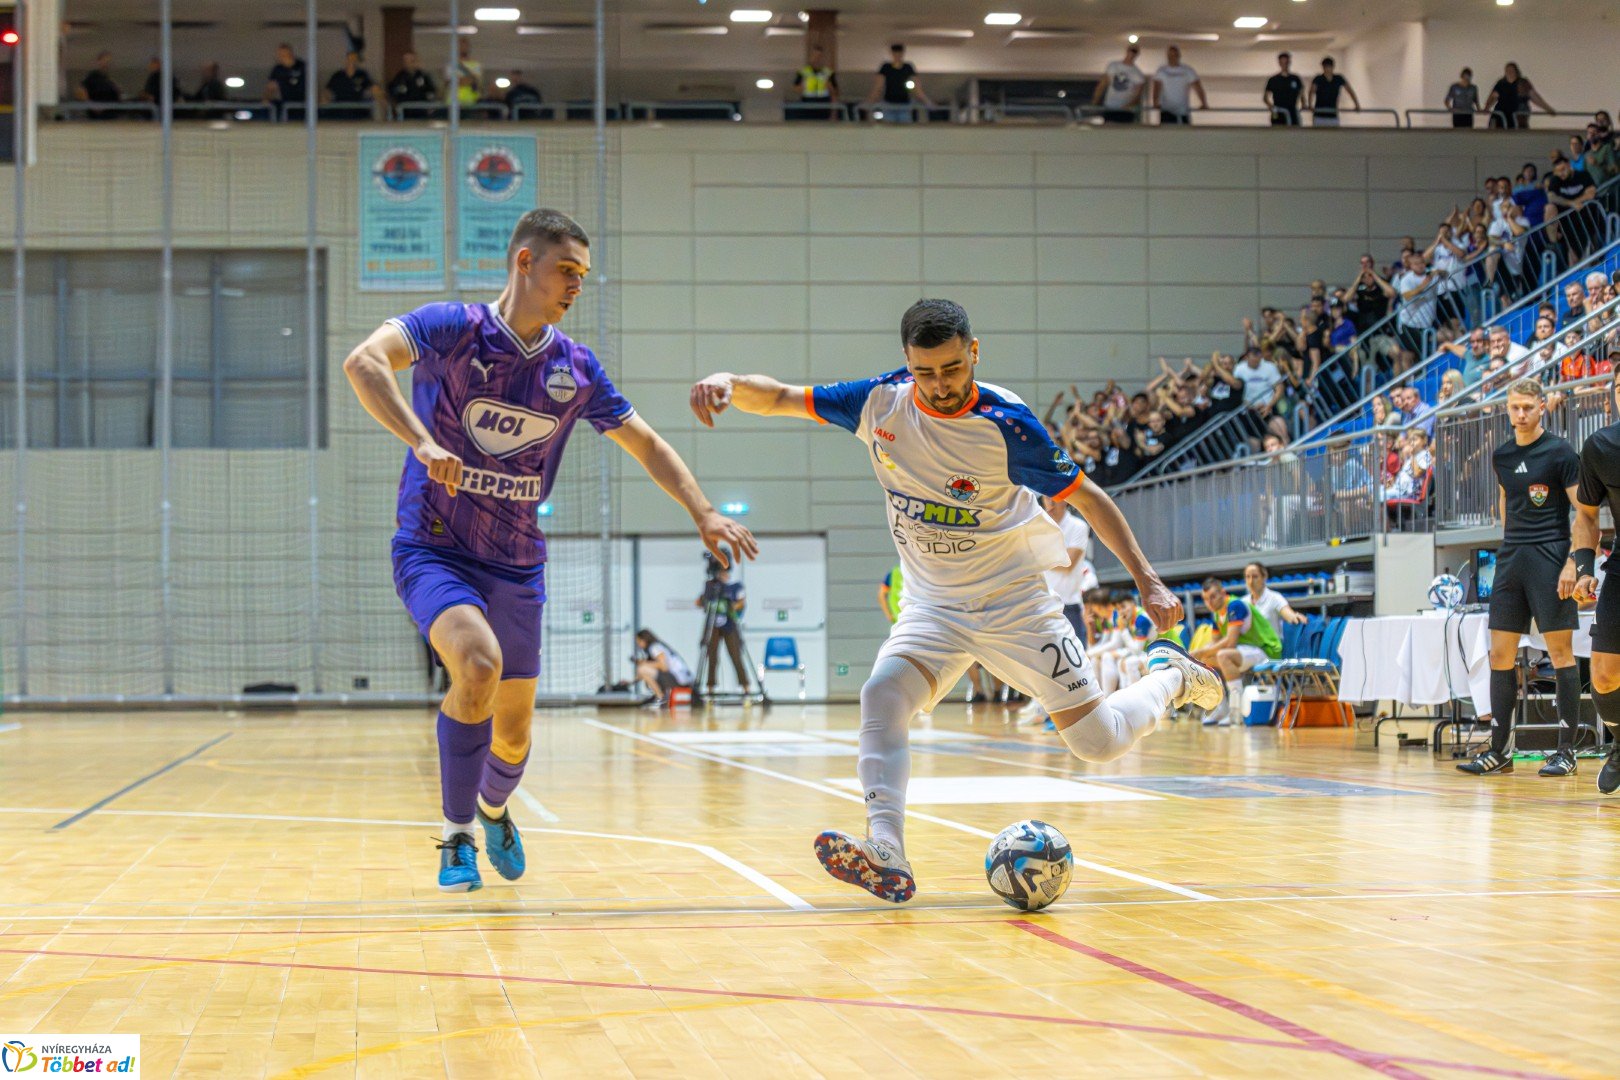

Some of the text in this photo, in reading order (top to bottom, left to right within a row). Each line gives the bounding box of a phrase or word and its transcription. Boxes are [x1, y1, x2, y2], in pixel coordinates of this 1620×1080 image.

[873, 427, 896, 441] JAKO
[893, 529, 976, 554] SUDIO
[1041, 637, 1082, 678] 20
[1067, 678, 1088, 691] JAKO
